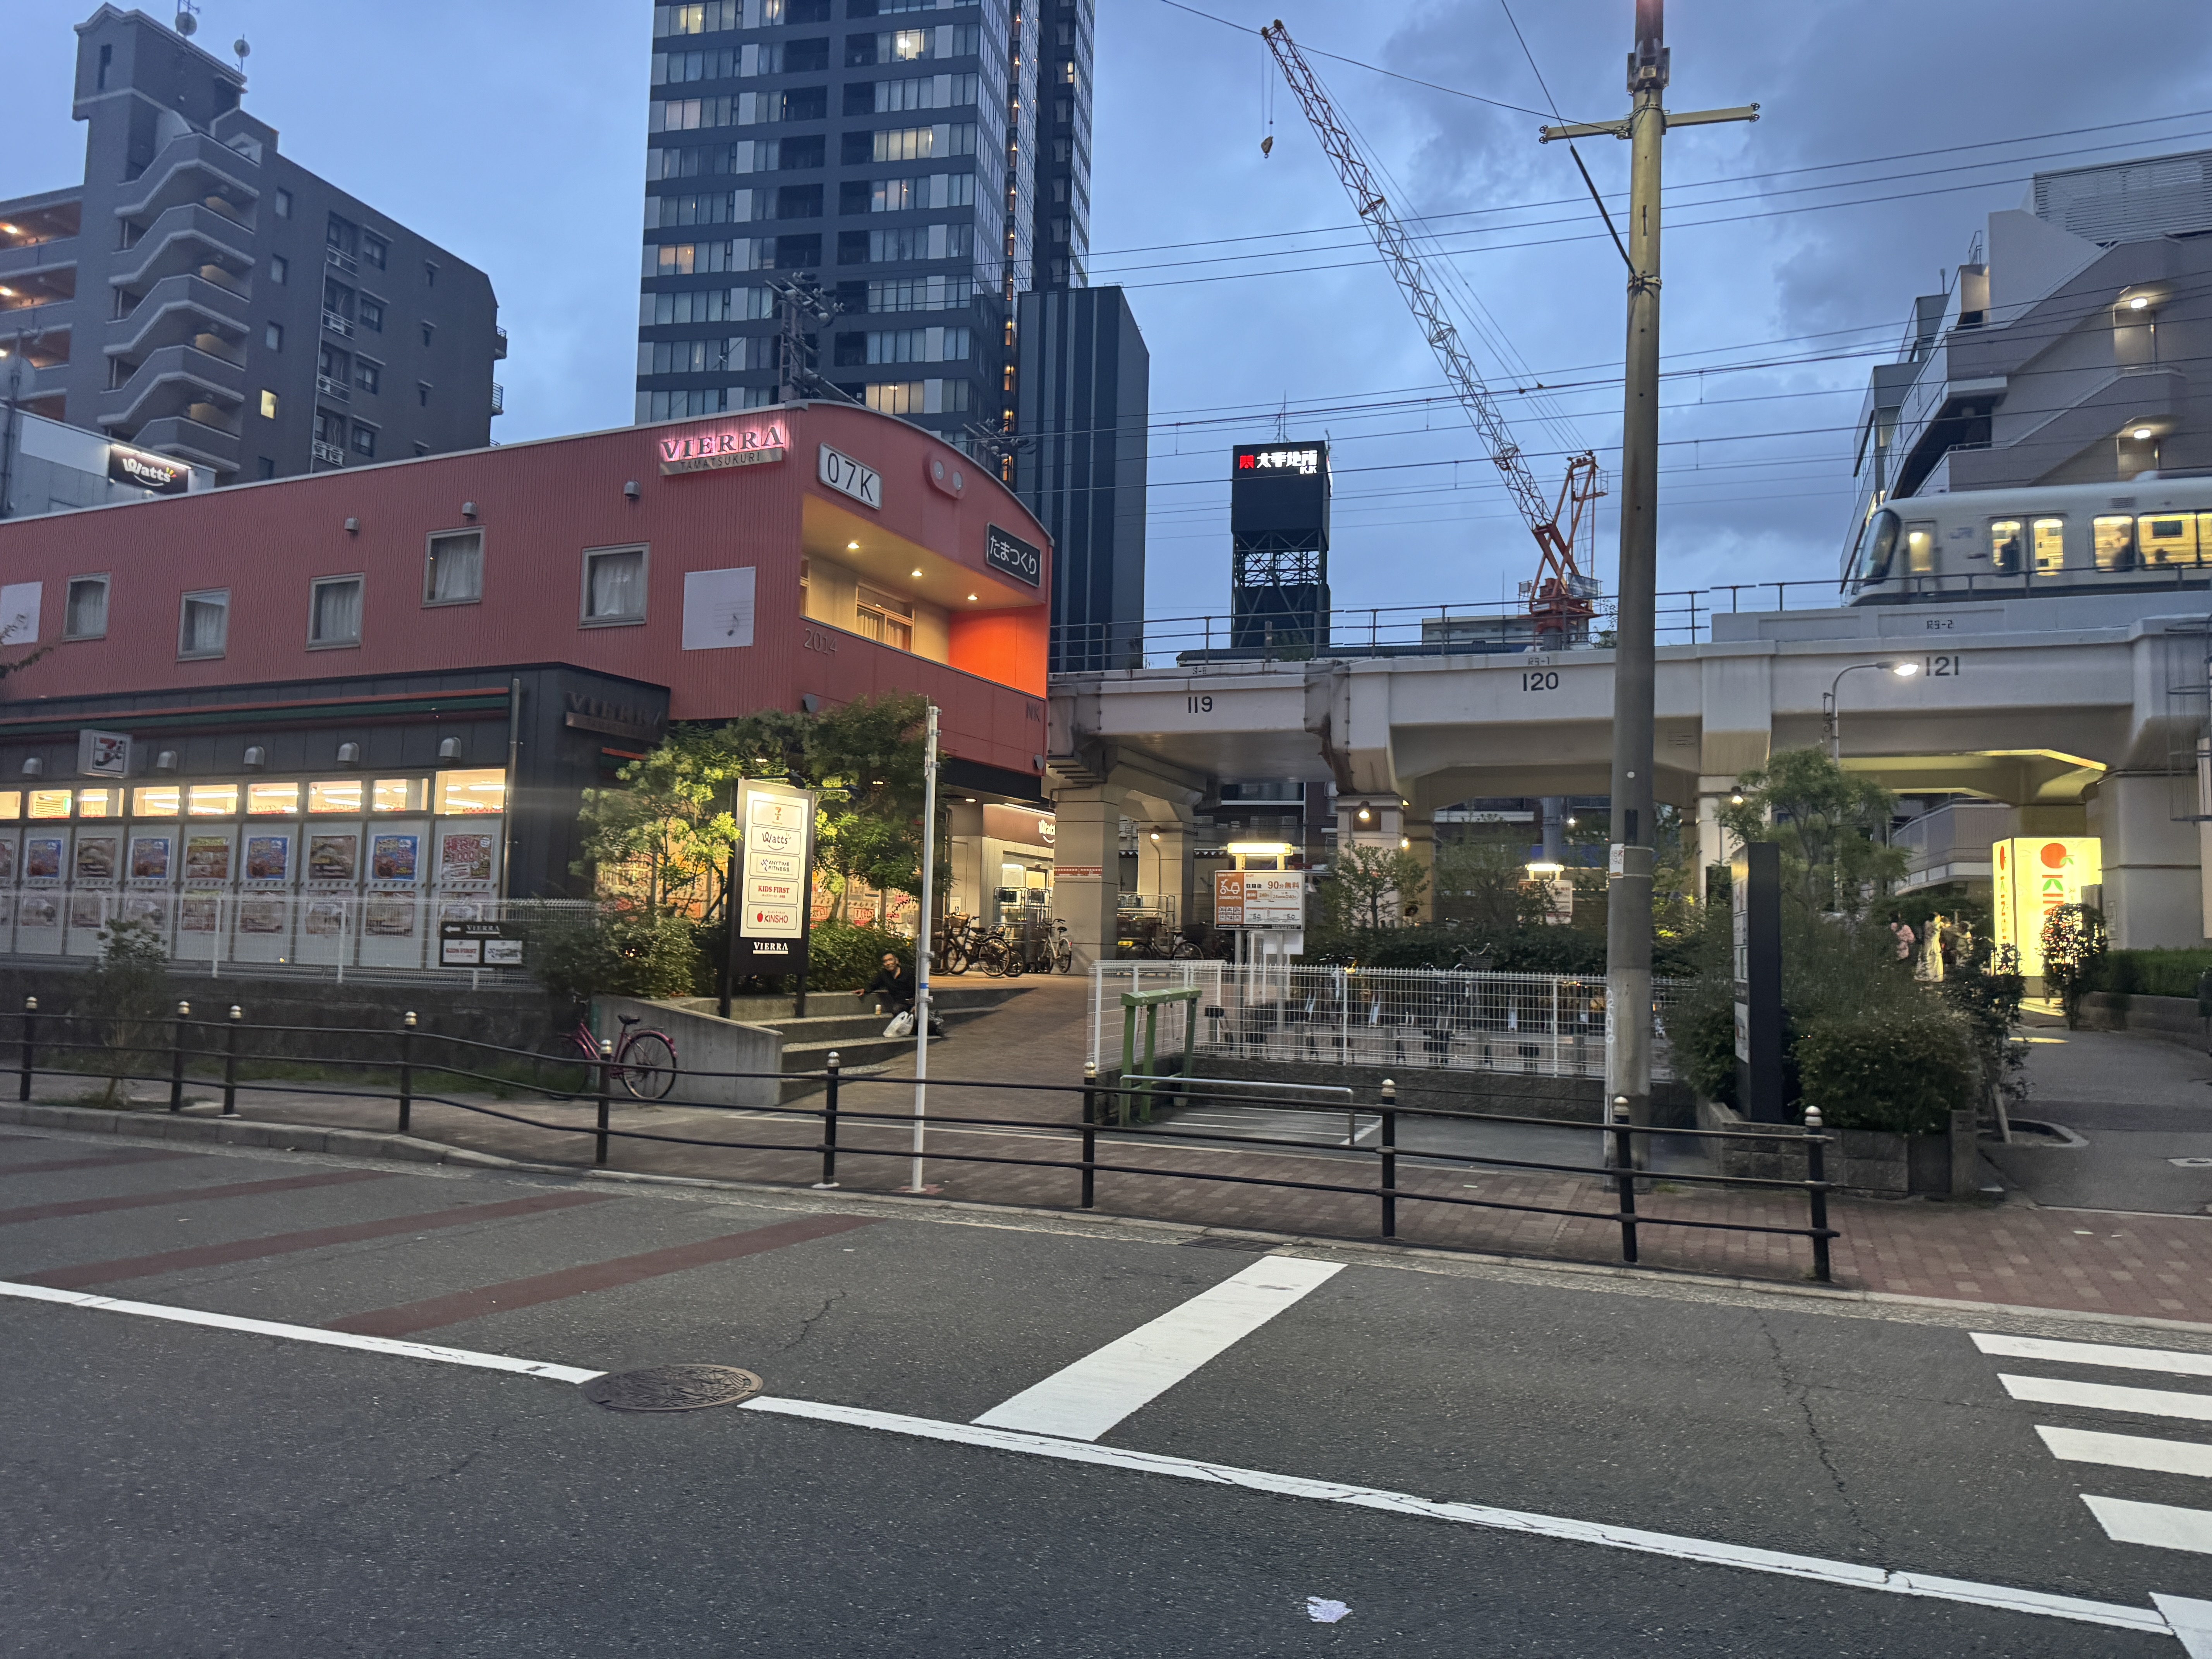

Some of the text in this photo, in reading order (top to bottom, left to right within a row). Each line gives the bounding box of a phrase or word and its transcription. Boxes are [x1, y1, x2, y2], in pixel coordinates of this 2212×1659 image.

[661, 426, 784, 459] VIERRA
[122, 458, 171, 483] Watts
[681, 452, 760, 471] TAMATSUKURI
[828, 453, 873, 502] 07K
[990, 535, 1037, 575] たまつくり
[804, 628, 838, 657] 2014
[1926, 656, 1959, 676] 121
[1523, 672, 1559, 692] 120
[1188, 696, 1212, 713] 119
[762, 831, 788, 845] Watts
[764, 914, 788, 923] KINSHO
[753, 941, 788, 950] VIERRA
